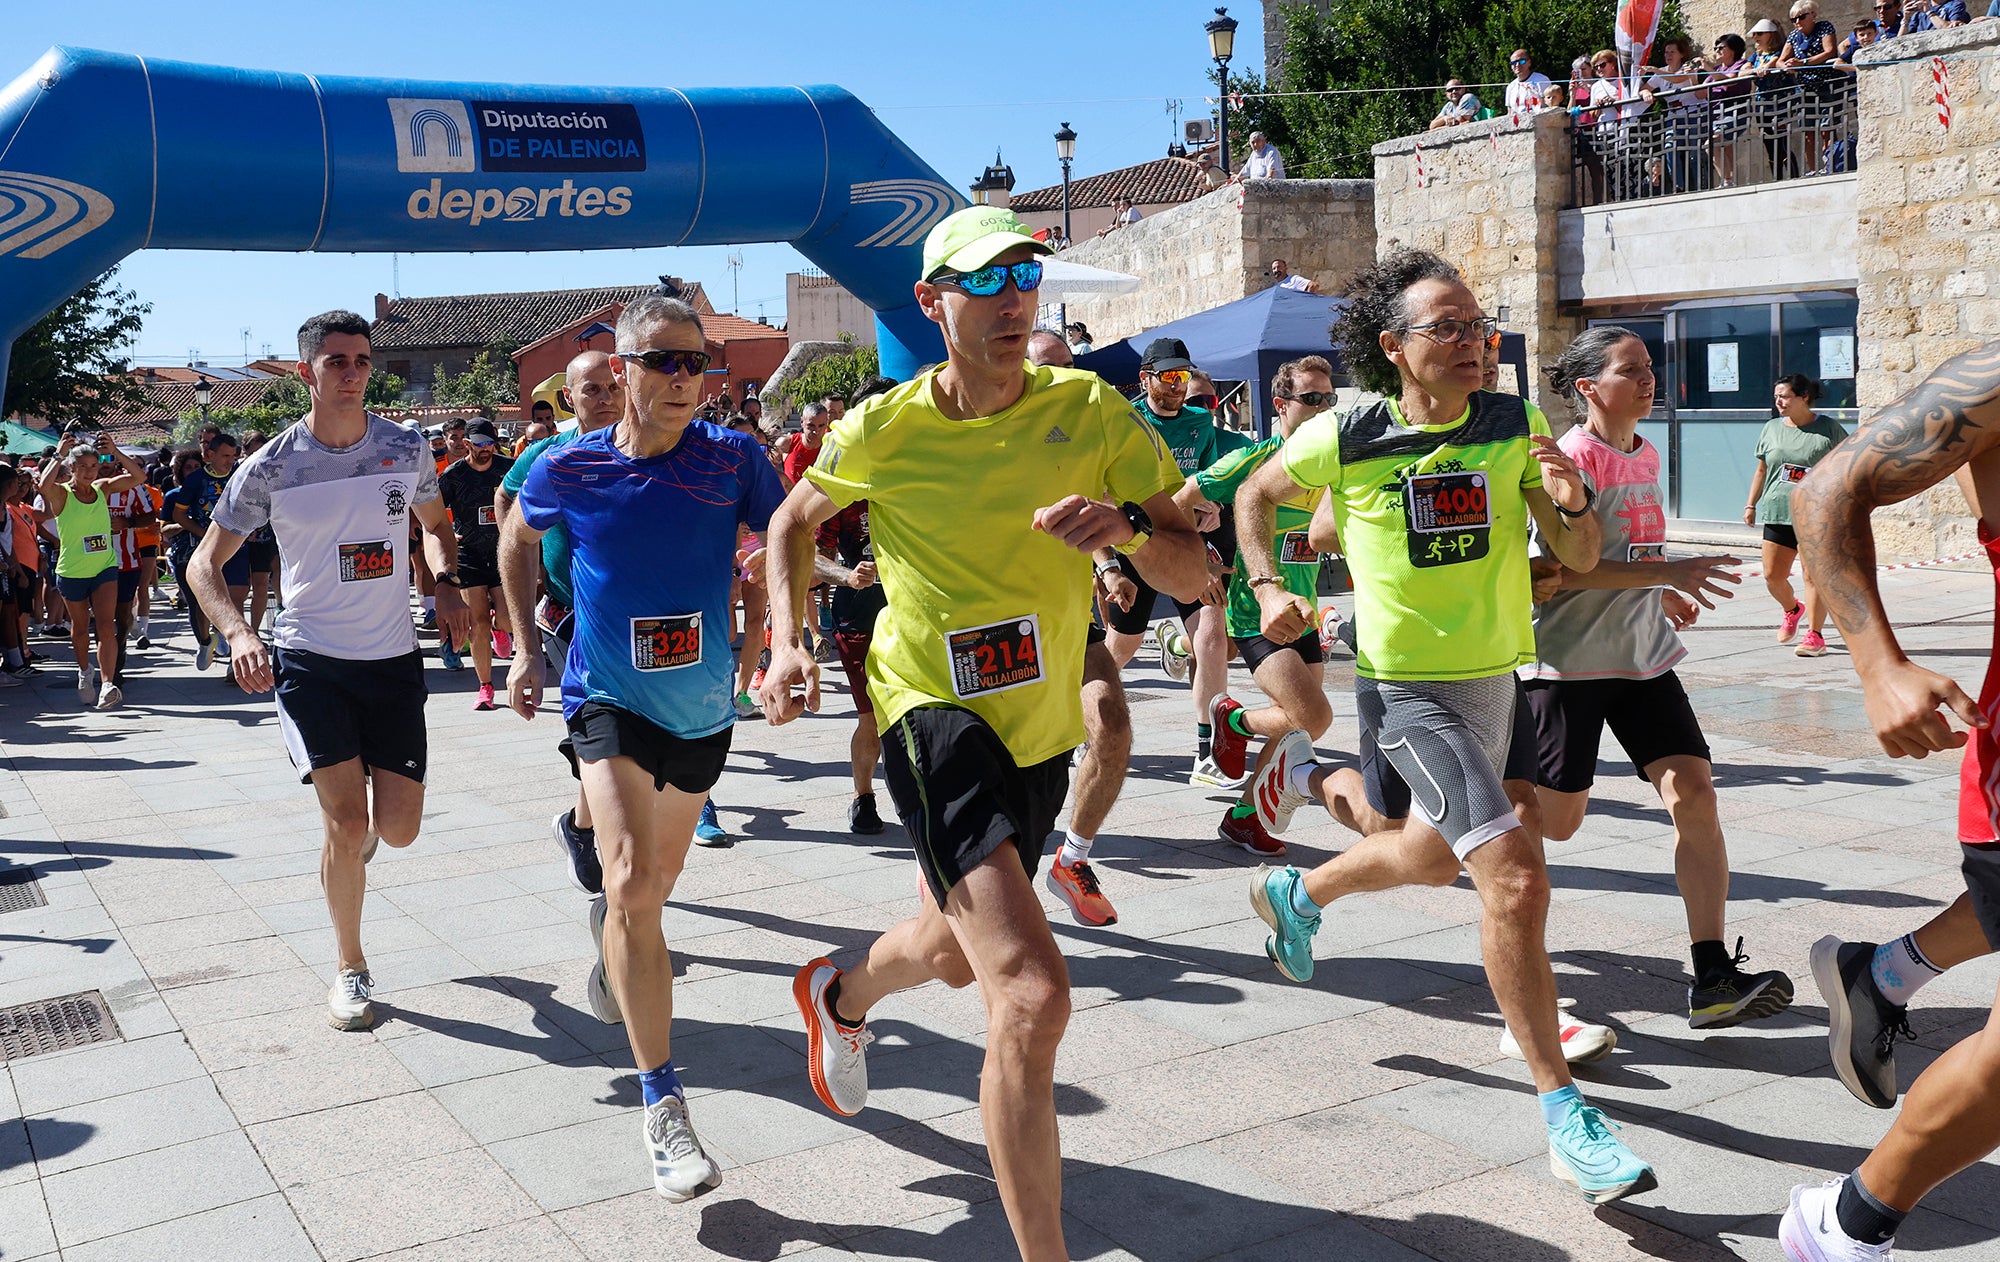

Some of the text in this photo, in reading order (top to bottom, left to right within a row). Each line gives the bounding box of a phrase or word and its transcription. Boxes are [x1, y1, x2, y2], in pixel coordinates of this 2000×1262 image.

[483, 110, 608, 131] Diputación
[488, 138, 640, 158] DE PALENCIA
[407, 178, 633, 226] deportes
[1434, 488, 1486, 514] 400
[1436, 512, 1486, 526] VILLALOBÓN
[91, 539, 107, 548] 510
[1458, 534, 1475, 557] P
[355, 550, 392, 570] 266
[355, 568, 392, 579] VILLALOBÓN
[654, 629, 698, 656] 328
[654, 651, 698, 666] VILLALOBÓN
[976, 636, 1036, 675] 214
[979, 665, 1038, 688] VILLALOBÓN
